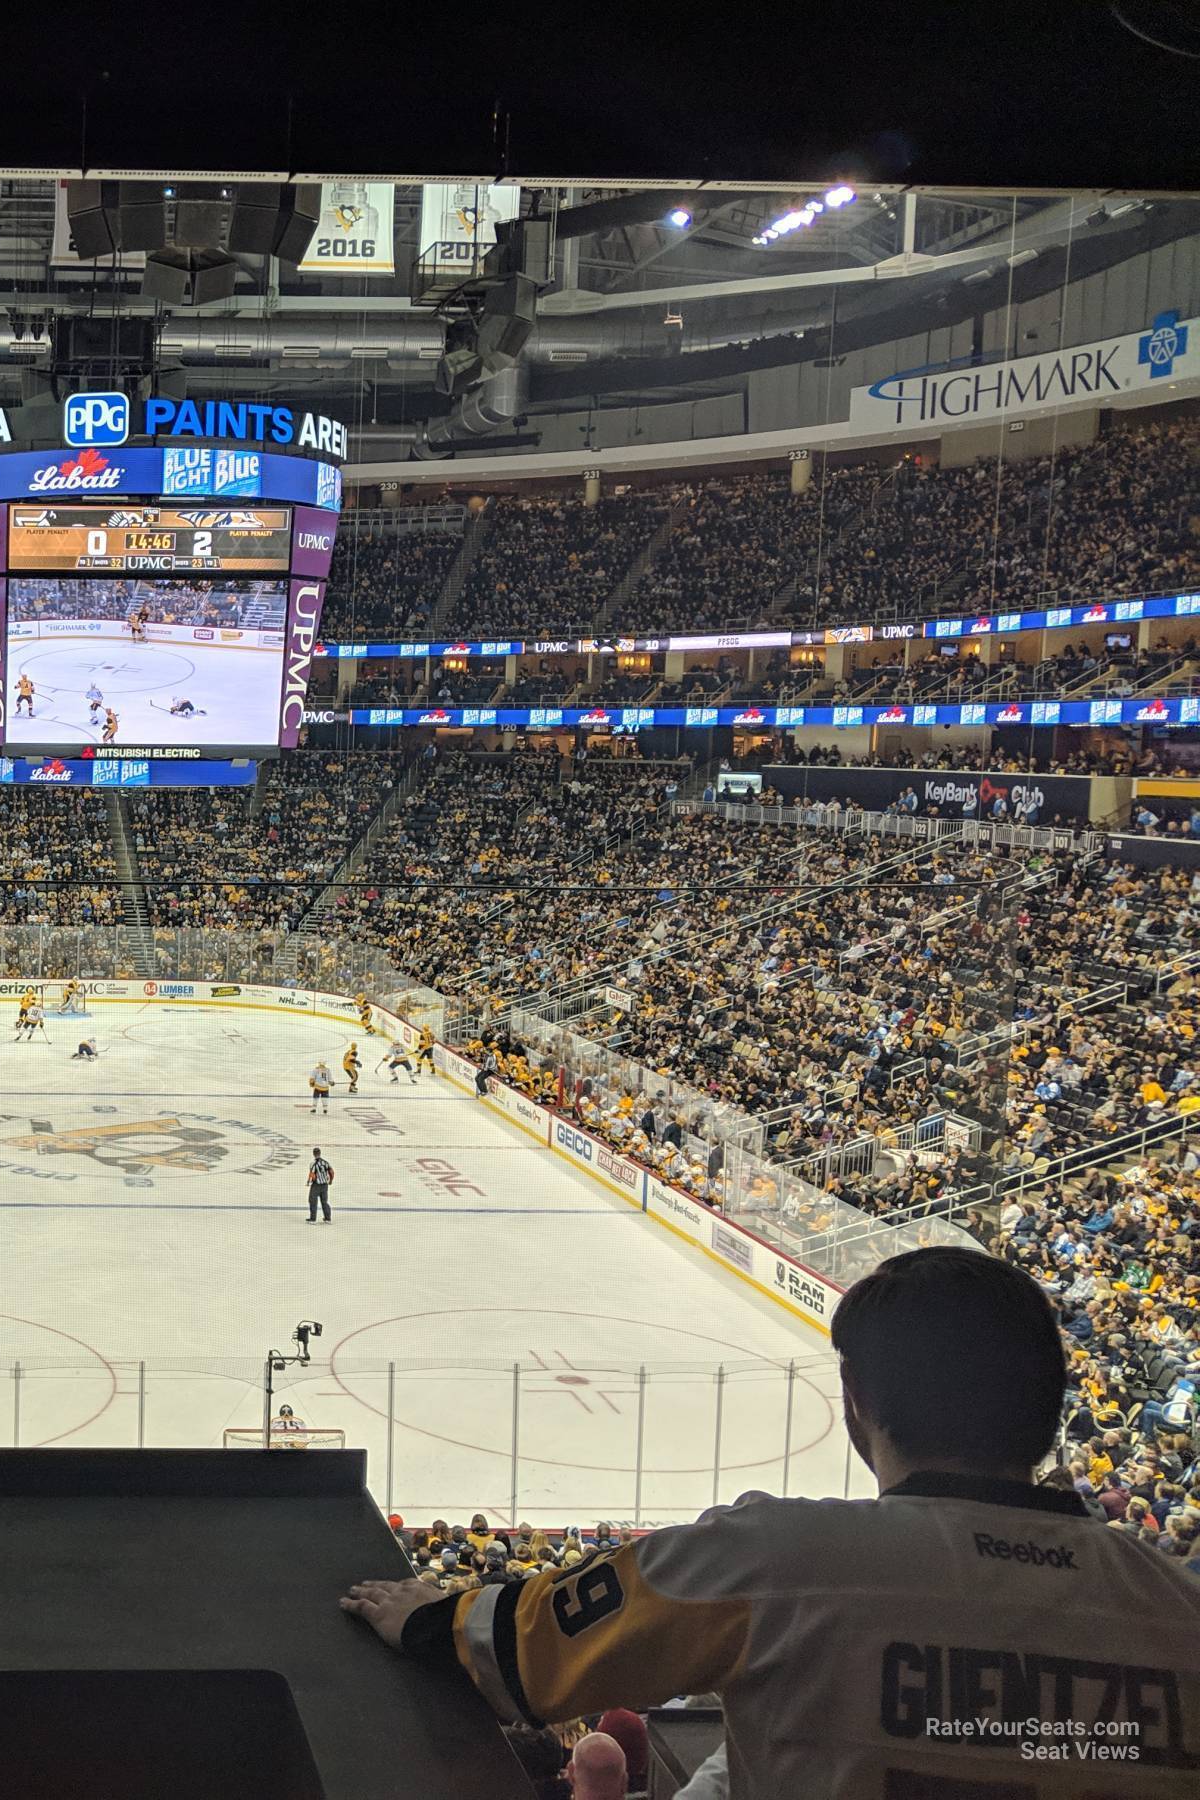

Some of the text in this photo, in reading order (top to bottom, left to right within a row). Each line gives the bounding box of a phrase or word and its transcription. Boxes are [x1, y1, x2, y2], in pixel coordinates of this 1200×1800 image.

[317, 239, 375, 257] 2016
[897, 346, 1120, 423] HIGHMARK
[69, 399, 124, 440] PPG
[146, 399, 293, 444] PAINTS
[788, 451, 807, 460] 232
[29, 464, 125, 490] Labatt
[216, 455, 260, 491] Blue
[583, 471, 600, 480] 231
[380, 482, 397, 490] 230
[87, 531, 107, 555] 0
[129, 534, 171, 549] 14:46
[193, 532, 212, 556] 2
[299, 533, 329, 550] UPMC
[111, 558, 121, 567] 32
[128, 557, 171, 569] UPMC
[192, 558, 202, 567] 23
[882, 625, 914, 638] UPMC
[535, 642, 567, 653] UPMC
[282, 583, 319, 730] UPMC
[578, 714, 611, 723] Labatt
[1136, 707, 1170, 720] Labatt
[501, 724, 517, 732] 120
[97, 749, 200, 758] MITSUBISHI ELECTRIC
[30, 768, 73, 782] Labatt
[121, 762, 149, 781] Blue
[925, 781, 977, 803] KeyBank
[677, 805, 690, 815] 121
[915, 823, 926, 834] 122
[978, 829, 990, 840] 101
[1055, 836, 1068, 848] 101
[82, 983, 104, 994] MC
[159, 984, 194, 994] LUMBER
[279, 995, 307, 1007] NHL.com
[159, 1110, 220, 1121] PPG
[344, 1105, 406, 1137] UPMC
[557, 1123, 592, 1161] GEICO
[416, 1157, 487, 1197] GNC
[789, 1273, 825, 1303] RAM
[789, 1285, 825, 1315] 1500
[973, 1532, 1080, 1570] Reebok
